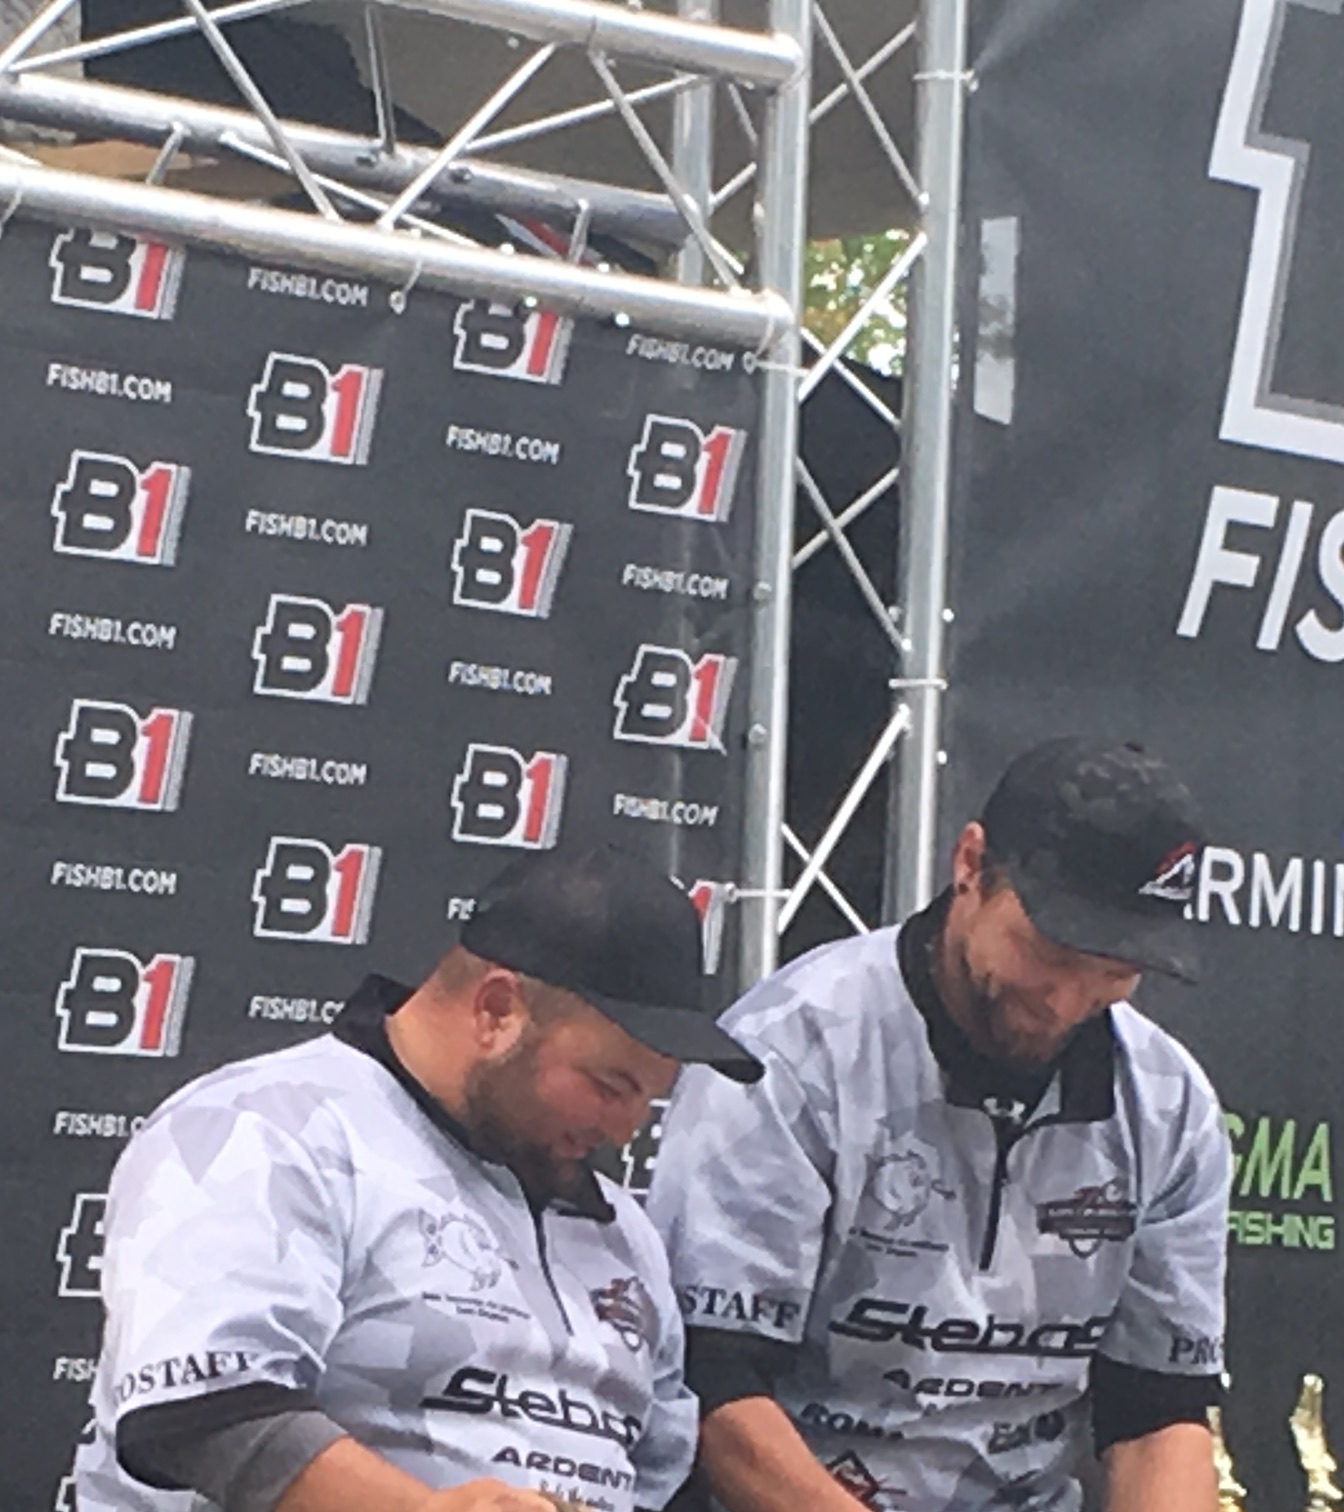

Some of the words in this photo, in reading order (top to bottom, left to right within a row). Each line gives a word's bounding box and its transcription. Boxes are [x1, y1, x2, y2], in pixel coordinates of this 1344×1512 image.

[248, 269, 368, 314] FISHB1.COM
[47, 364, 171, 402] FISHB1.COM
[246, 352, 383, 465] B1
[51, 449, 191, 566] B1
[627, 414, 744, 522] B1
[246, 509, 367, 545] FISHB1.COM
[451, 509, 573, 619] B1
[49, 613, 176, 649] FISHB1.COM
[251, 594, 383, 704] B1
[614, 644, 735, 753] B1
[55, 699, 194, 811] B1
[249, 753, 366, 784] FISHB1.COM
[451, 743, 568, 849] B1
[51, 862, 176, 894] FISHB1.COM
[251, 836, 382, 944] B1
[55, 947, 194, 1057] B1
[491, 1446, 632, 1491] ARDENT
